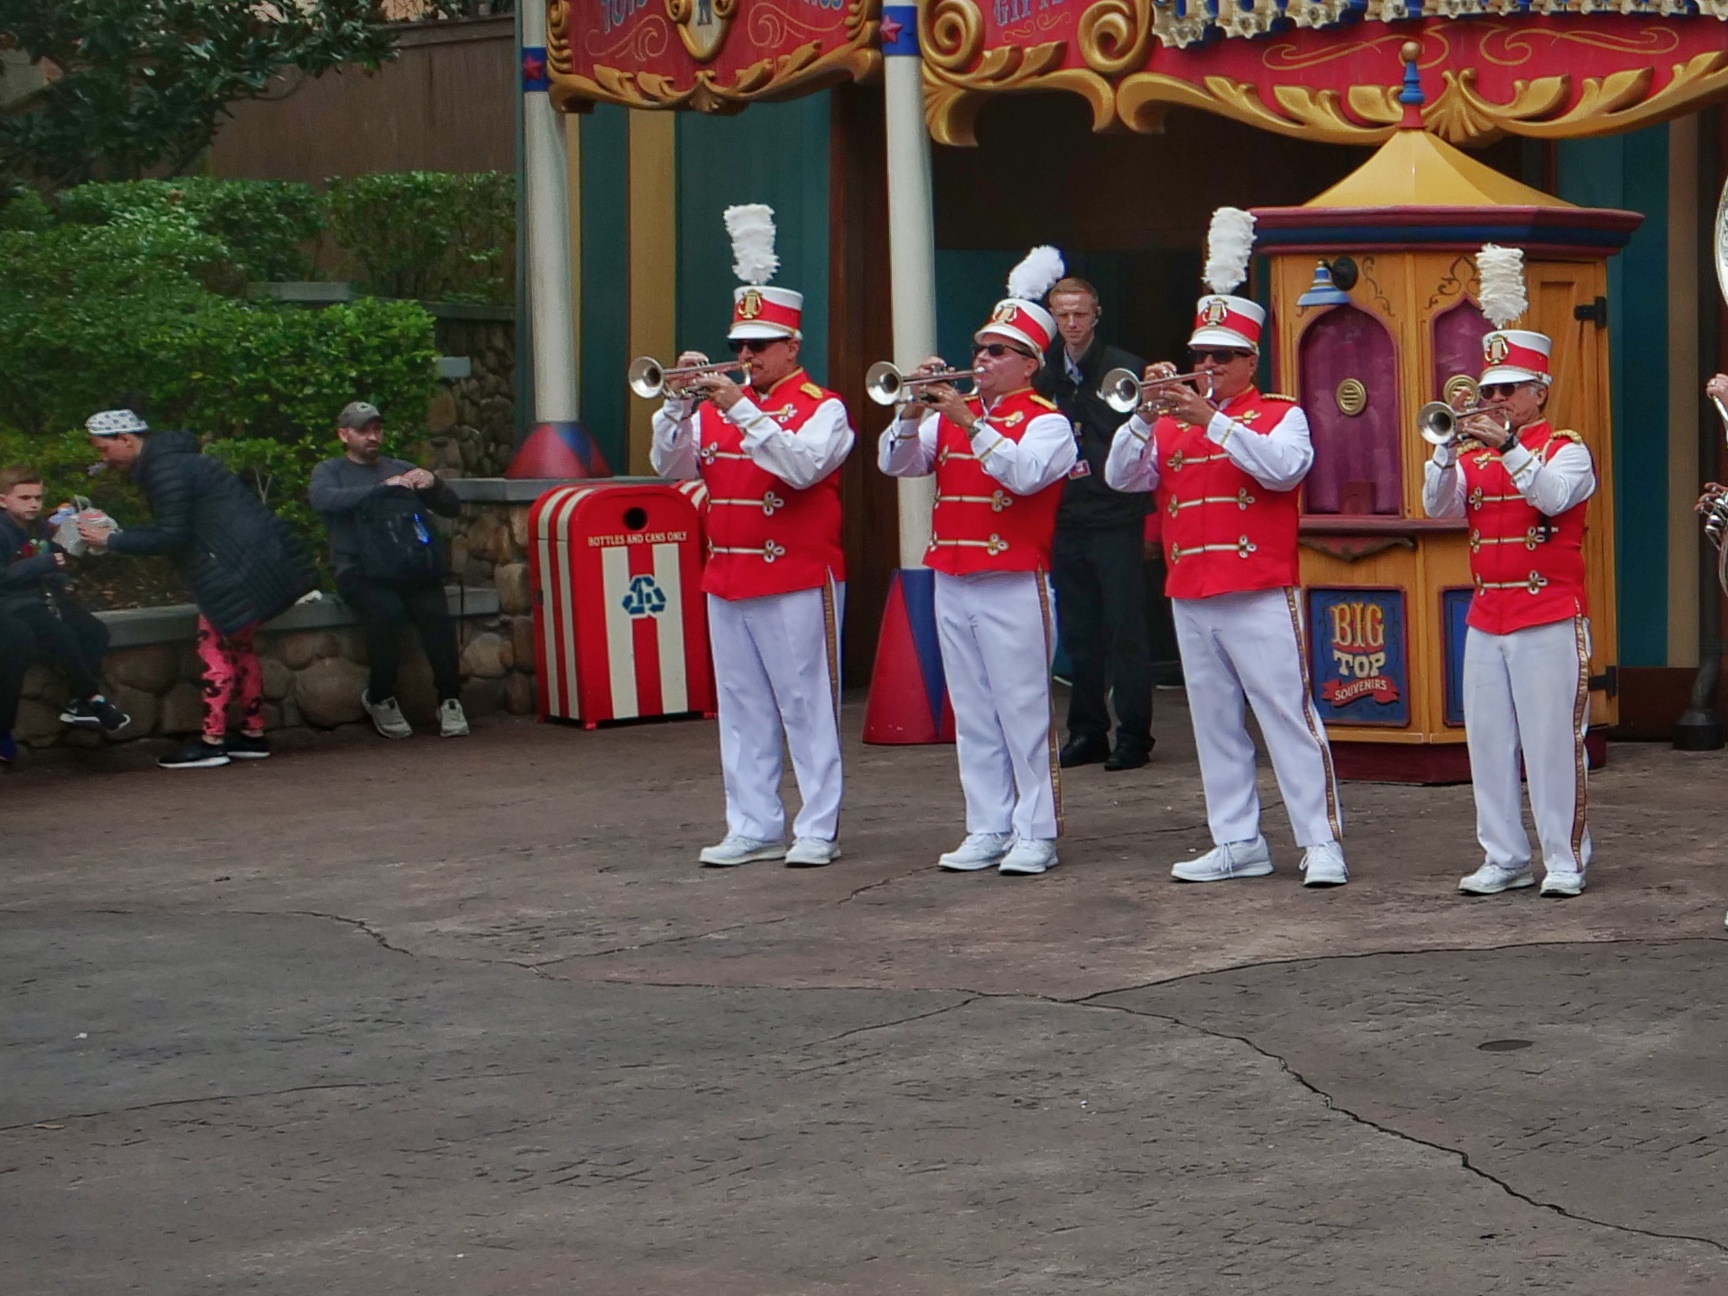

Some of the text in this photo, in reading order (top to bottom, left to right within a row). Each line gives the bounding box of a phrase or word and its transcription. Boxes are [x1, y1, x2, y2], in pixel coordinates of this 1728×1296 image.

[588, 531, 687, 547] BOTTLES AND CANS ONLY
[1330, 602, 1385, 647] BIG
[1332, 650, 1386, 679] TOP
[1334, 679, 1387, 701] SOUVENIRS
